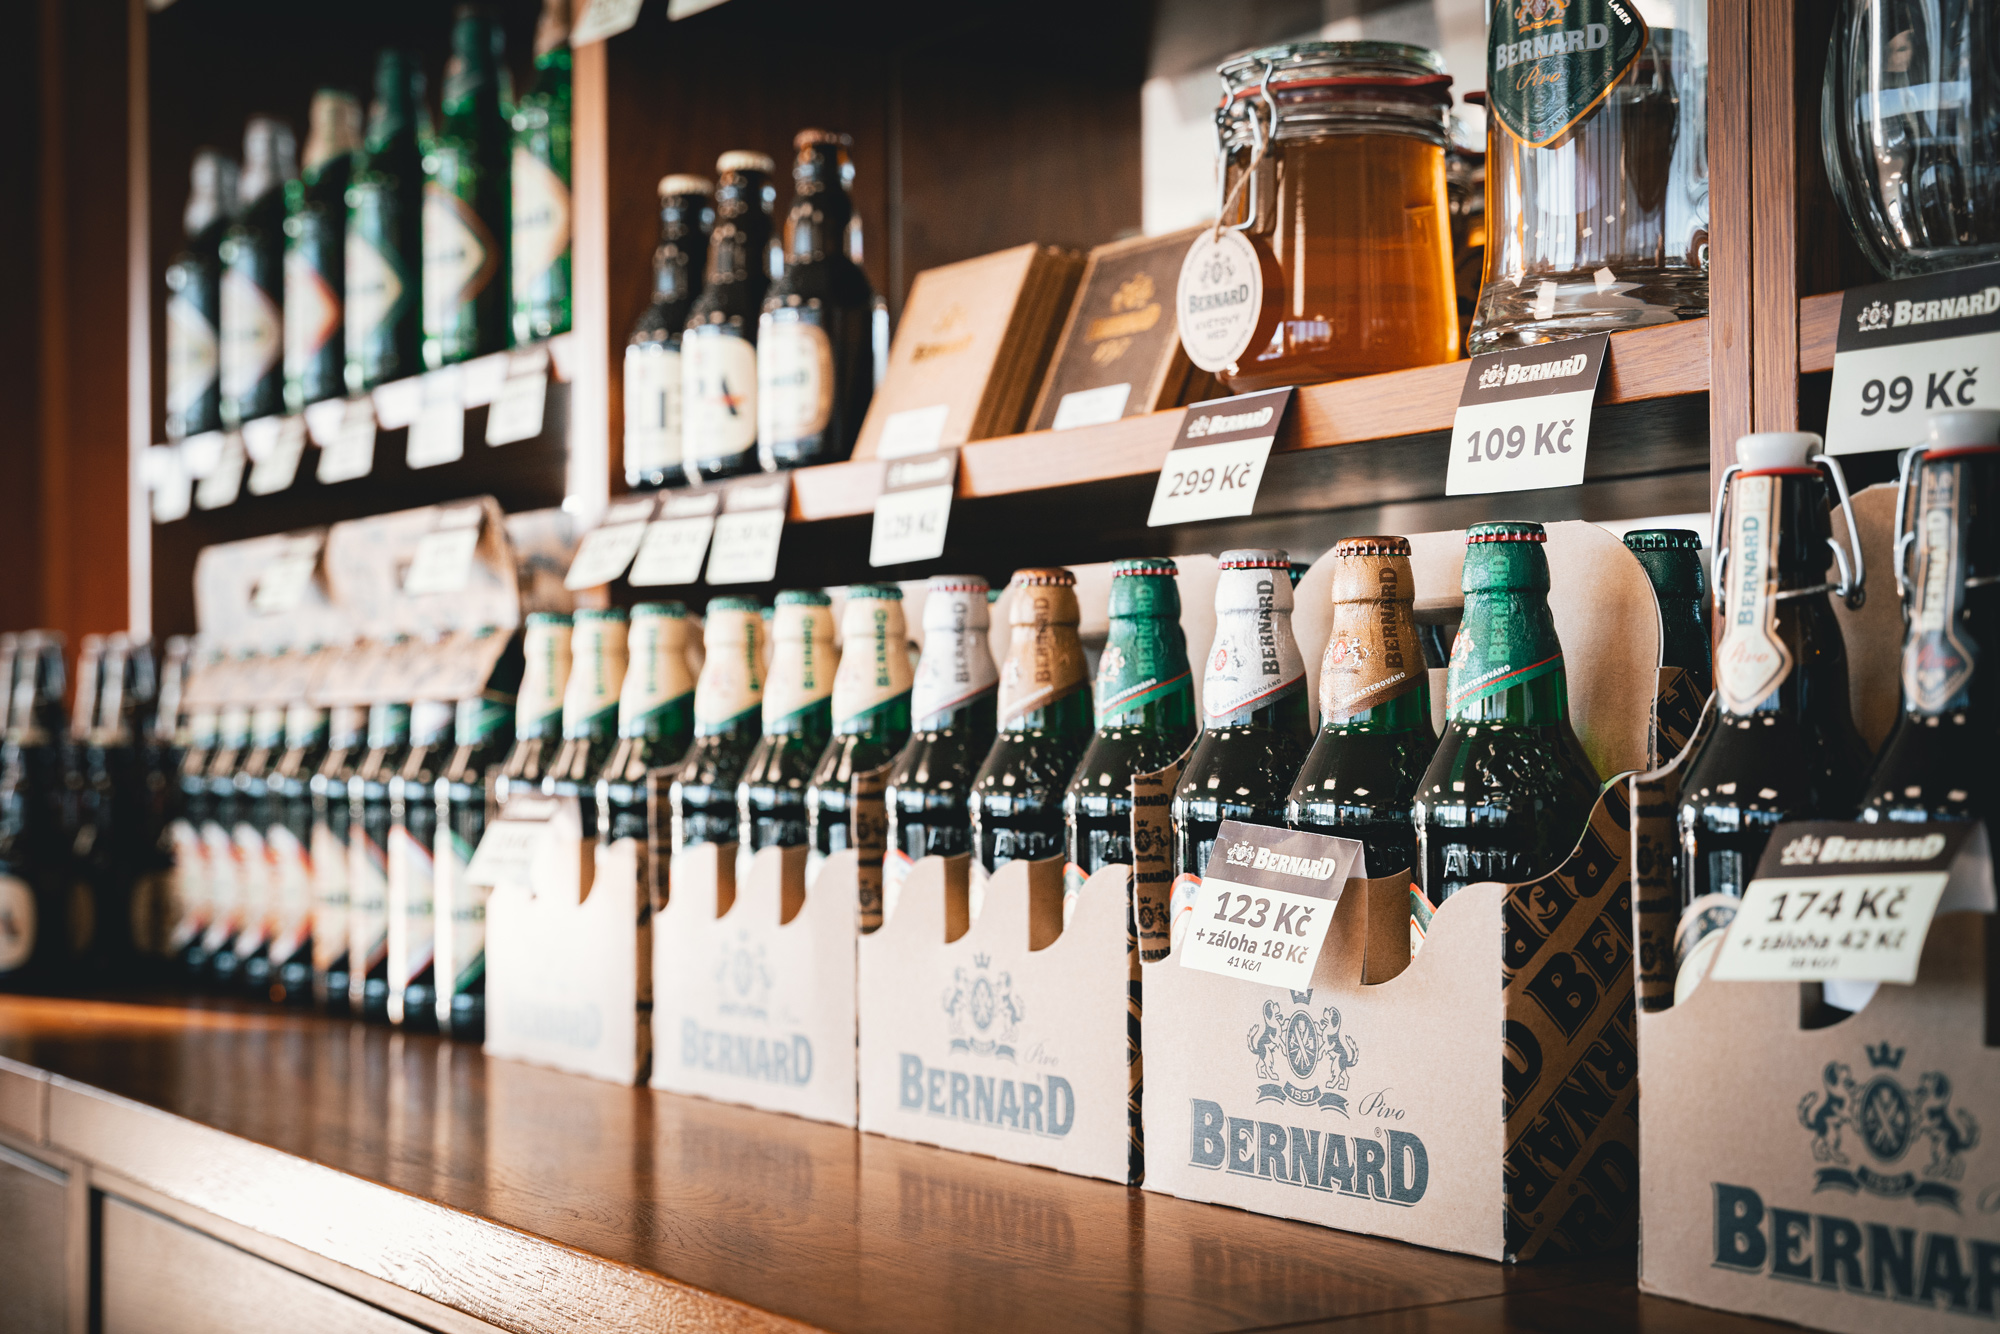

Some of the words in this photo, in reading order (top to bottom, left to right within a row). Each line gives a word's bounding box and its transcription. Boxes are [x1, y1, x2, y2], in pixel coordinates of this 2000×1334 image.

[1607, 0, 1632, 26] LAGER
[1496, 23, 1609, 71] BERNARD
[1516, 65, 1562, 91] Pivo
[1189, 284, 1249, 314] BERNARD
[1892, 285, 2000, 328] BERNARD
[1504, 354, 1588, 386] BERNARD
[1860, 375, 1914, 417] 99
[1925, 366, 1980, 410] Kč
[1207, 406, 1274, 436] BERNARD
[1467, 425, 1526, 463] 109
[1533, 418, 1575, 456] Kč
[1167, 467, 1216, 498] 299
[1219, 461, 1254, 491] Kč
[1738, 515, 1761, 626] BERNARD
[1257, 579, 1281, 675] BERNARD
[1379, 567, 1404, 669] BERNARD
[1489, 555, 1511, 662] BERNARD
[1136, 584, 1156, 677] BERNARD
[1251, 846, 1336, 881] BERNARD
[1818, 833, 1946, 864] BERNARD
[1213, 890, 1271, 929] 123
[1273, 901, 1316, 938] Kč
[1768, 889, 1844, 923] 174
[1854, 884, 1910, 920] Kč
[1206, 930, 1258, 954] záloha
[1261, 939, 1285, 960] 18
[1285, 944, 1310, 965] Kč
[1758, 930, 1830, 953] záloha
[1227, 956, 1240, 968] 41
[681, 1016, 814, 1090] BERNARD
[899, 1052, 1075, 1141] BERNARD
[1290, 1088, 1316, 1101] 1597
[1358, 1087, 1406, 1121] Pivo
[1188, 1097, 1429, 1207] BERNARD
